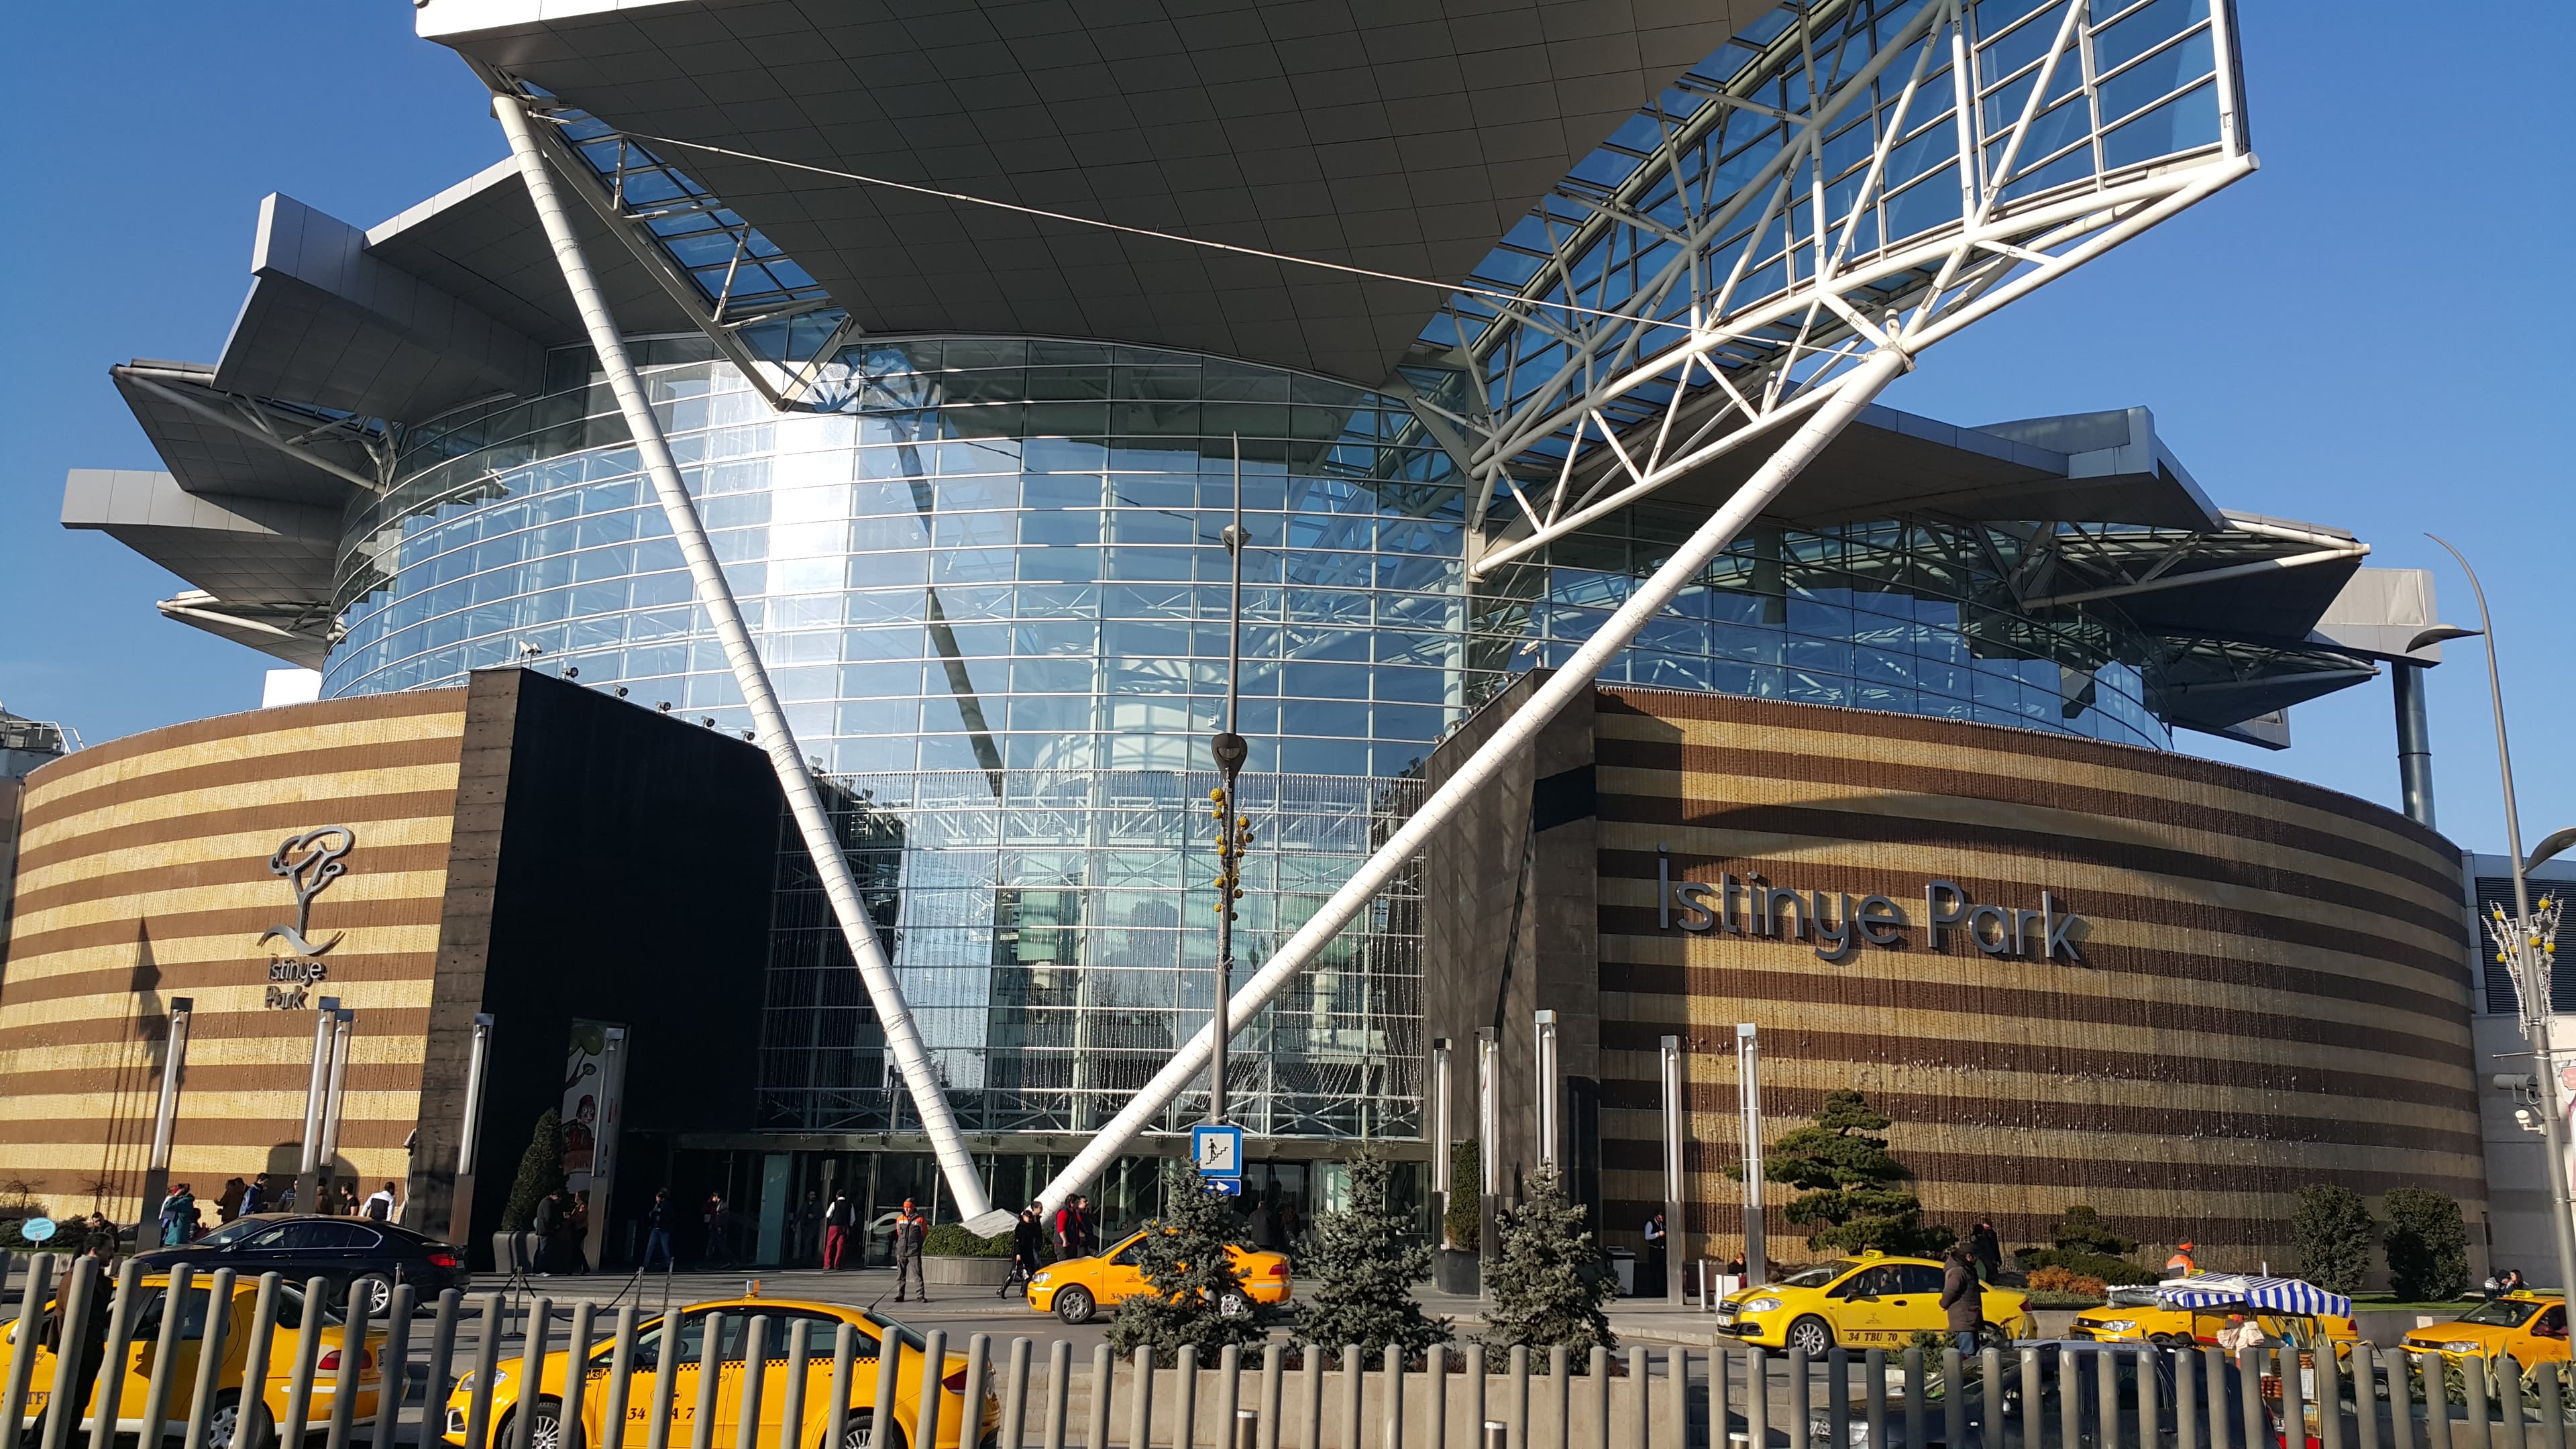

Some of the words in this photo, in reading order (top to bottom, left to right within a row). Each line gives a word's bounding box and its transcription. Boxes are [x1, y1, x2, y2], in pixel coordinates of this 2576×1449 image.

[1925, 879, 2080, 960] Park
[265, 985, 308, 1010] Park
[1848, 1332, 1860, 1342] 34
[1864, 1332, 1883, 1342] TBU
[1887, 1332, 1898, 1342] 70
[586, 1369, 602, 1379] aksi
[627, 1407, 646, 1420] 34
